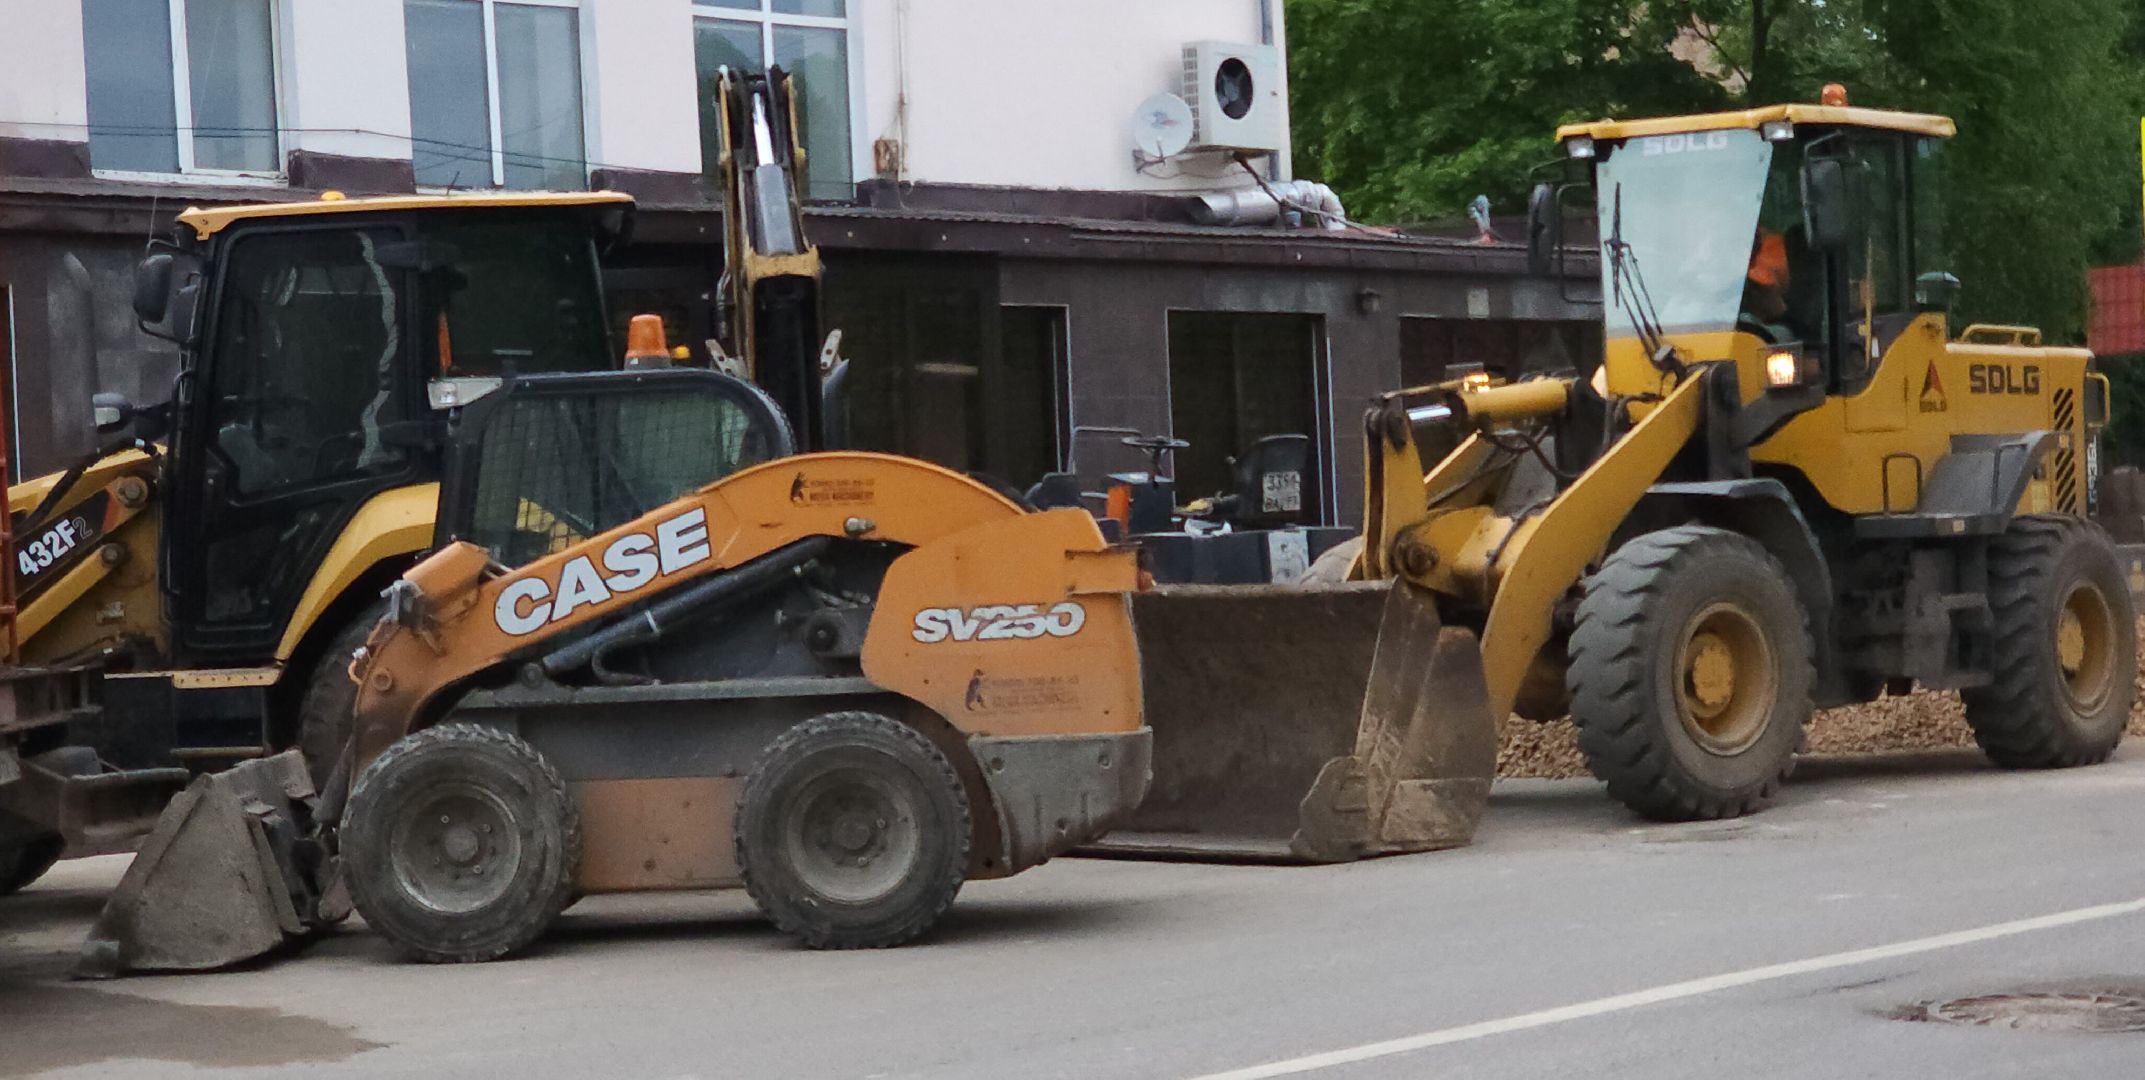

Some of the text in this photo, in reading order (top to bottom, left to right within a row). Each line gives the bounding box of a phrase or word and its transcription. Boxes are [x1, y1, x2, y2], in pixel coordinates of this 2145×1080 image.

[1643, 131, 1728, 156] SDLG
[1968, 364, 2040, 395] SDLG
[18, 516, 94, 576] 432F2
[494, 505, 711, 636] CASE
[911, 601, 1086, 643] SV250
